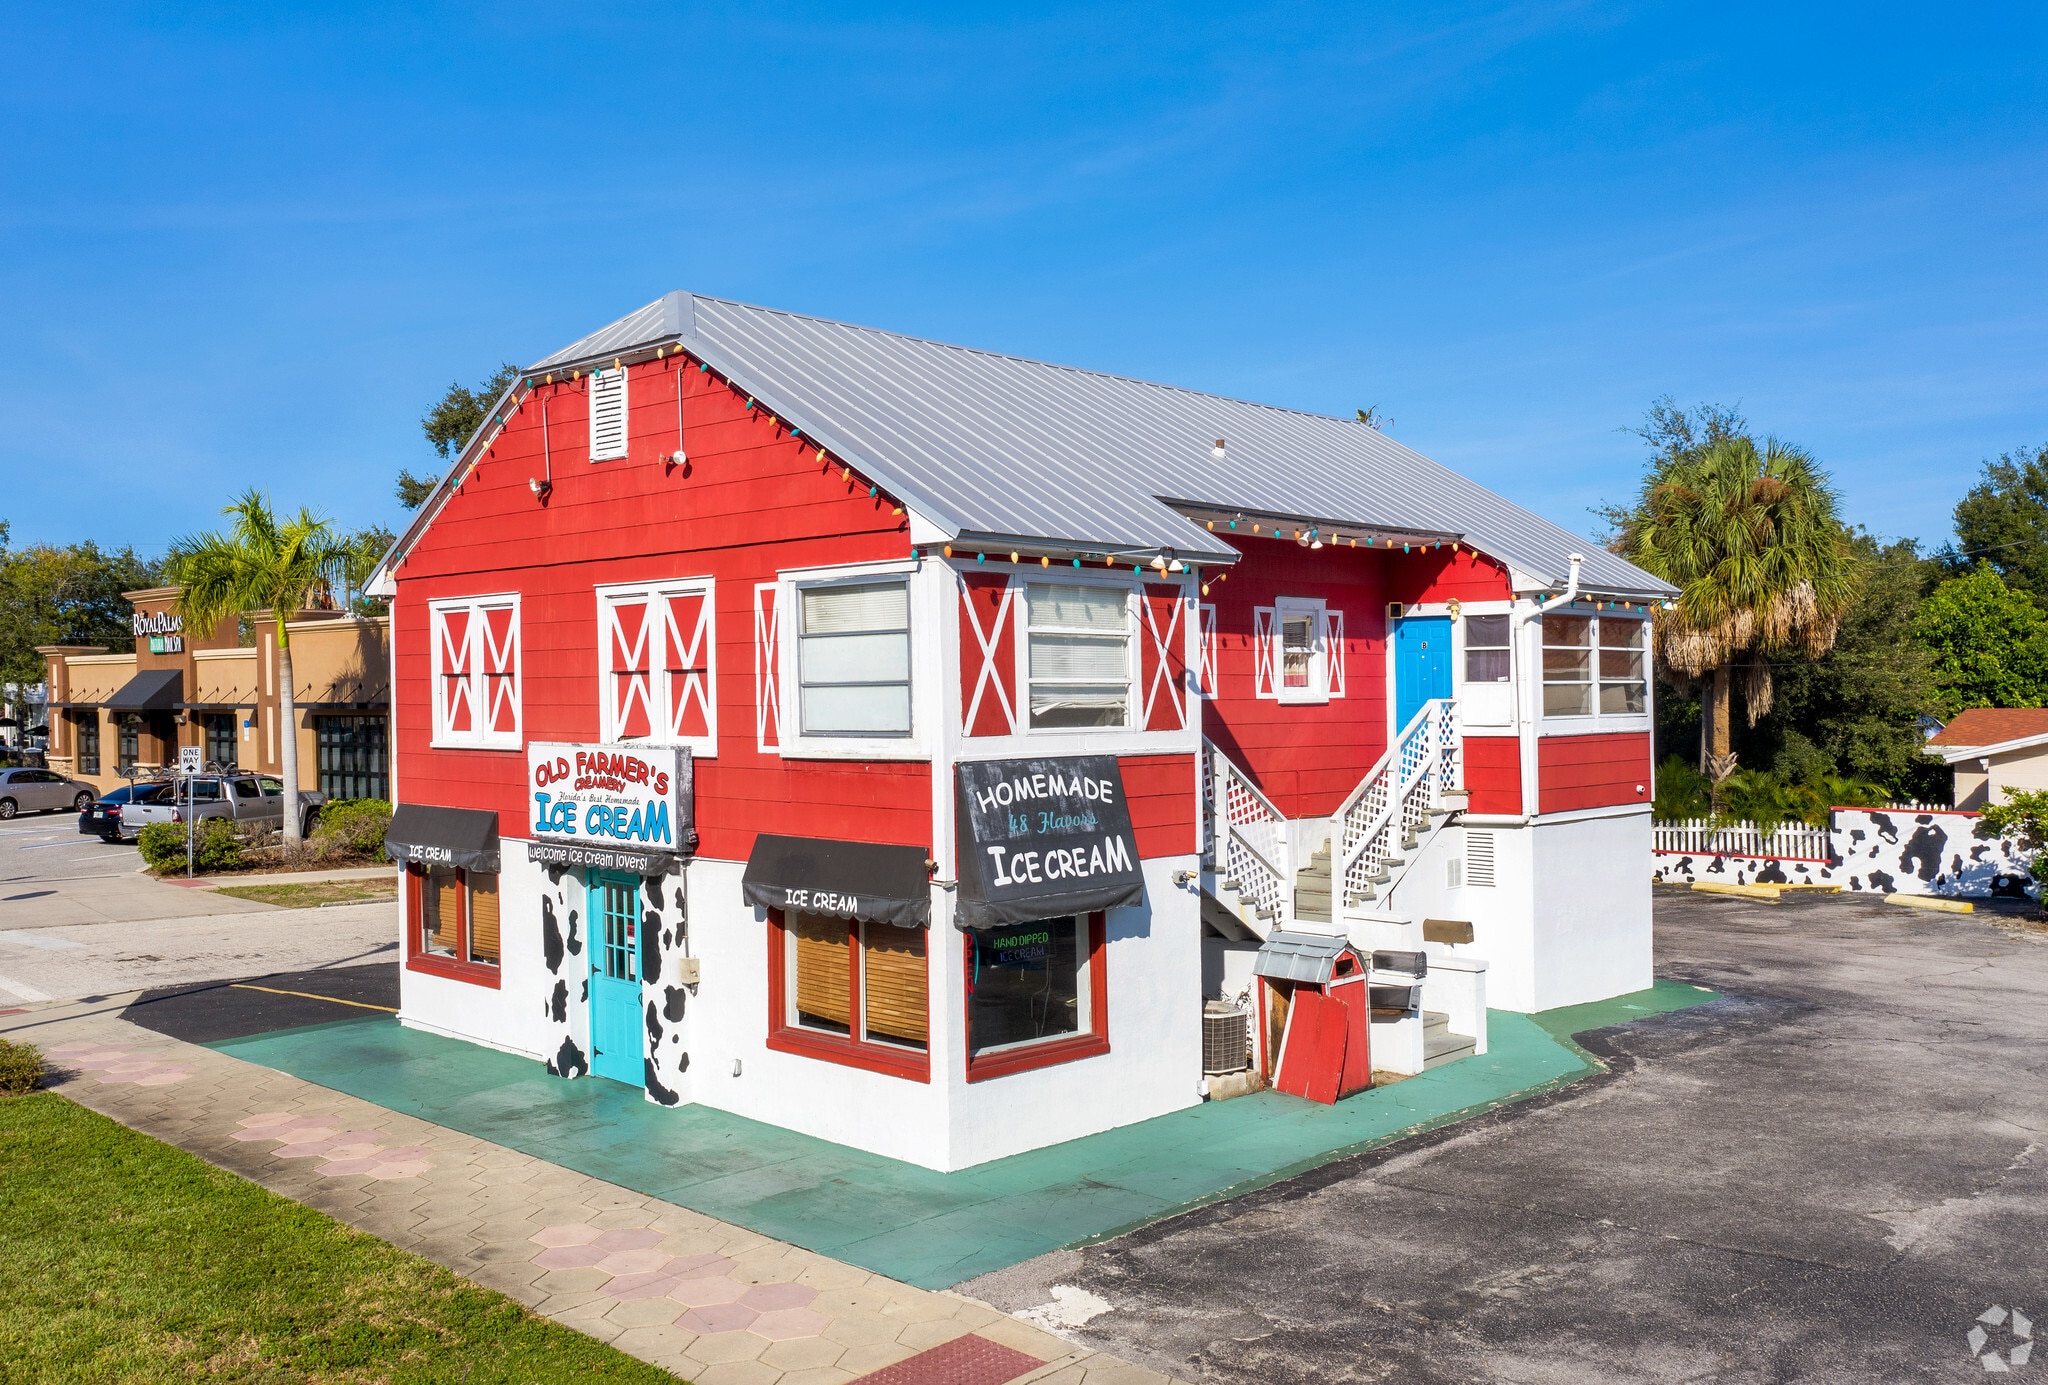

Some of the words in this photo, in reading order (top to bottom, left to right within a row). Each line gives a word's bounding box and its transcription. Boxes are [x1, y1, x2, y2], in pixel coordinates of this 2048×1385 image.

[133, 613, 158, 636] ROYAL
[183, 748, 200, 756] ONE
[183, 756, 200, 764] WAY
[535, 757, 570, 787] OLD
[576, 751, 669, 795] FARMER'S
[574, 775, 626, 793] CREAMERY
[558, 790, 586, 802] Florida's
[588, 793, 603, 804] Best
[604, 794, 641, 806] Homemade
[976, 774, 1113, 813] HOMEMADE
[535, 792, 577, 834] ICE
[585, 800, 671, 844] CREAM
[1008, 813, 1028, 834] 48
[1036, 811, 1099, 834] Flavors
[408, 844, 423, 858] ICE
[425, 846, 452, 862] CREAM
[529, 846, 566, 861] welcome
[568, 848, 583, 862] ice
[584, 851, 614, 867] cream
[616, 854, 648, 870] lovers!
[986, 846, 1043, 887] ICE
[1044, 834, 1133, 880] CREAM
[785, 888, 808, 907] ICE
[812, 892, 858, 913] CREAM
[993, 935, 1018, 949] HAND
[1018, 932, 1049, 946] DIPPED
[999, 950, 1012, 962] ICE
[1014, 946, 1045, 960] CREAM
